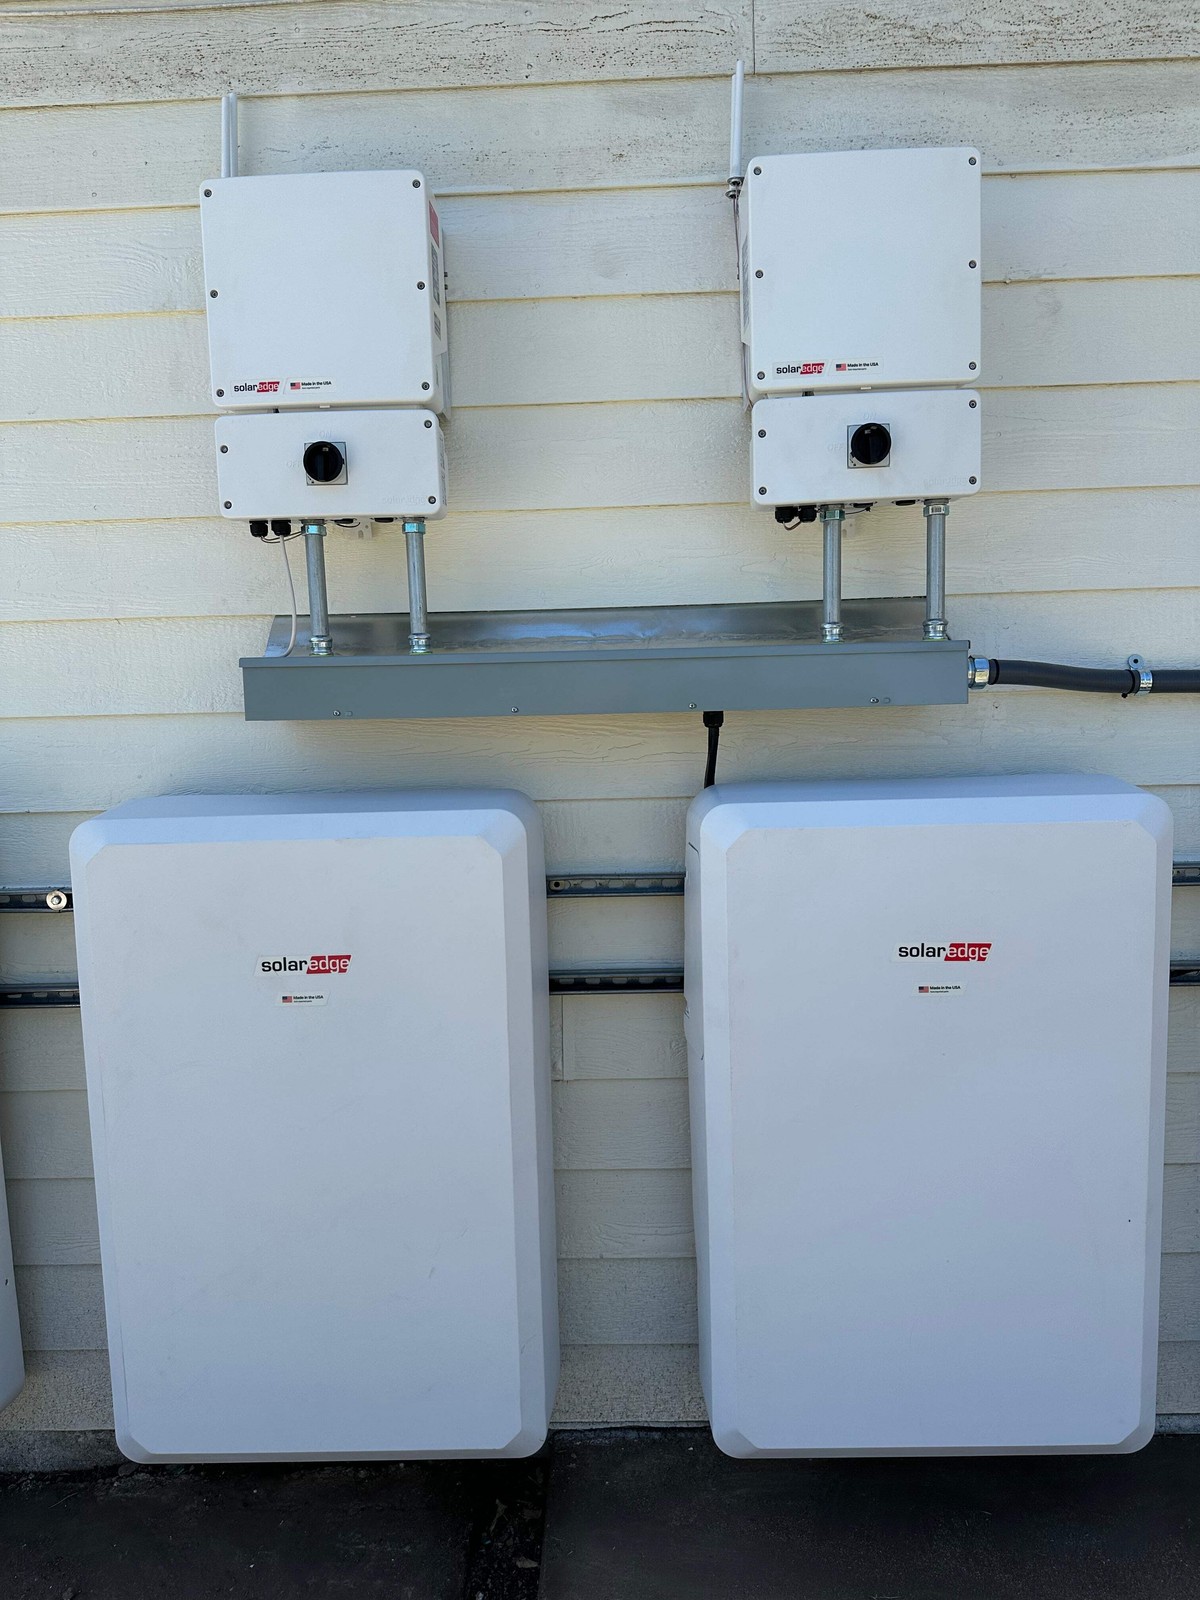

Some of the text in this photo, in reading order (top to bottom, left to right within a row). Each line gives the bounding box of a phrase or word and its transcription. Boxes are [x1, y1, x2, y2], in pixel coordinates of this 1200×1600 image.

[776, 363, 824, 375] solaredge
[234, 381, 279, 392] solaredge
[319, 430, 332, 439] ON
[898, 943, 991, 961] solaredge
[261, 955, 351, 974] solaredge
